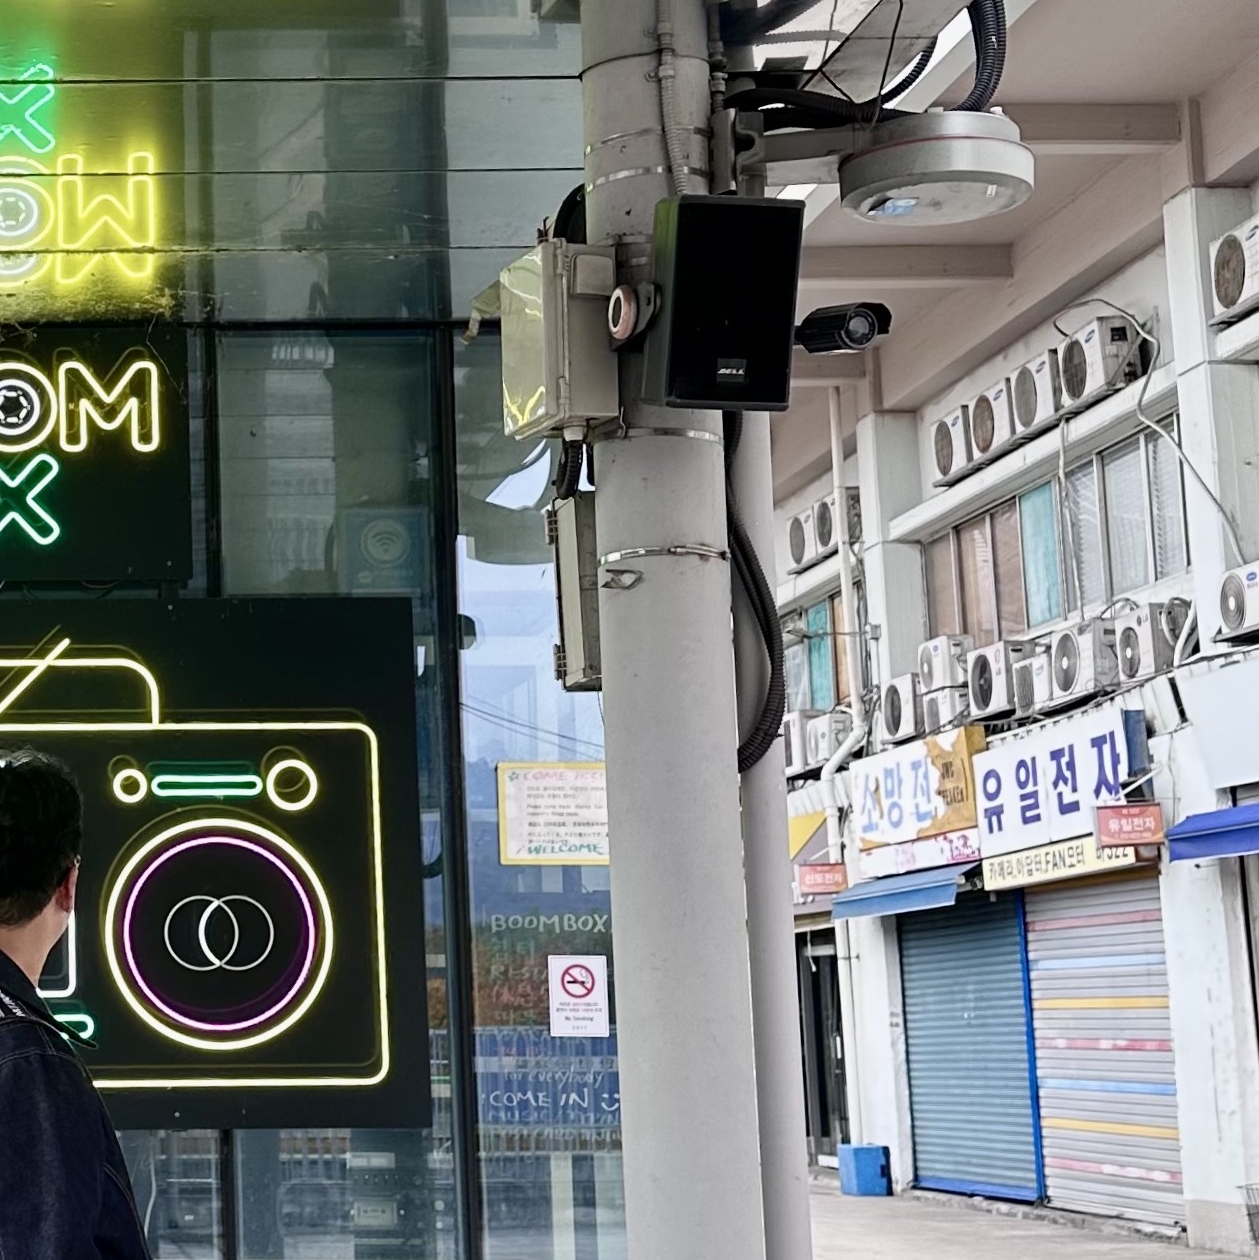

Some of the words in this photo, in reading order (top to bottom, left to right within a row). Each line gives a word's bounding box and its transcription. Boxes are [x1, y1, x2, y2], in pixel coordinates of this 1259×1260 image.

[982, 730, 1121, 834] 유일전자
[1108, 816, 1156, 833] 유일전자
[527, 843, 605, 855] WELCOME
[528, 1063, 605, 1089] everybody
[489, 1090, 552, 1107] COME
[559, 1087, 589, 1108] IN
